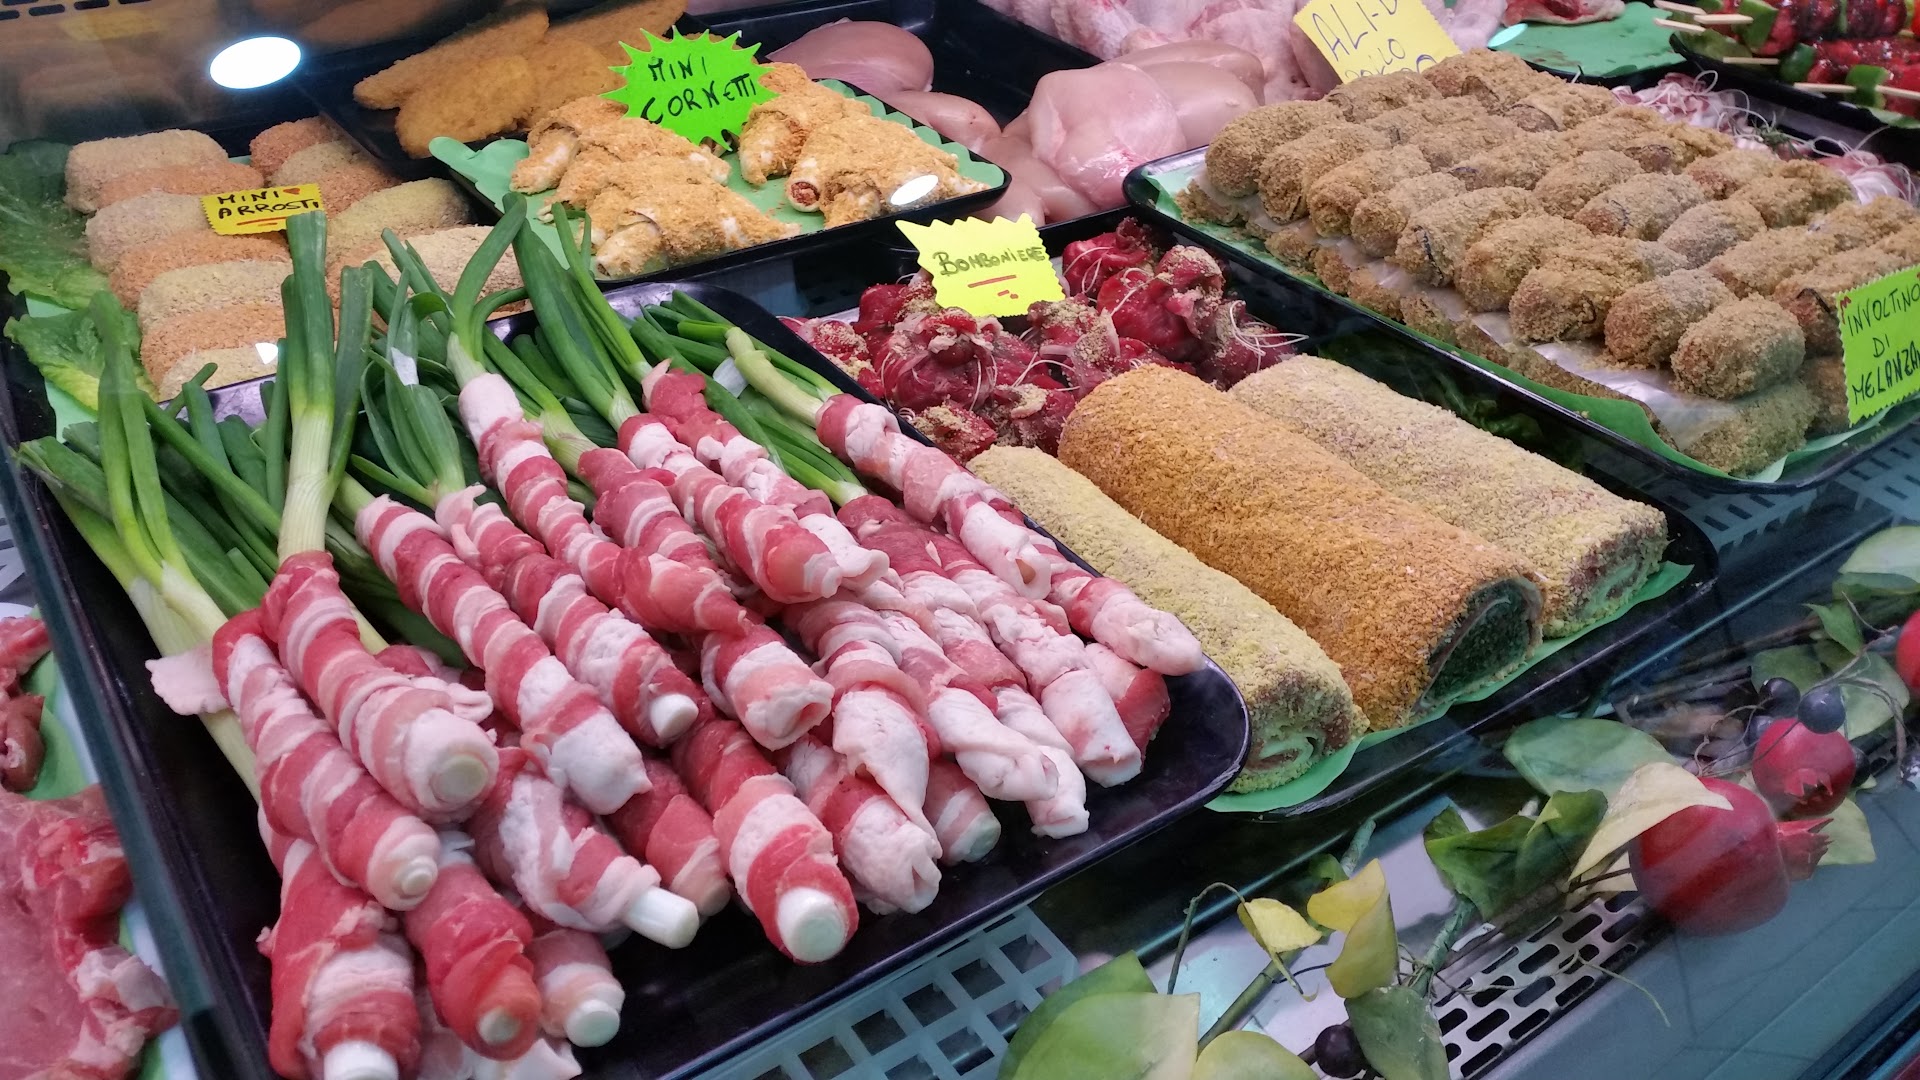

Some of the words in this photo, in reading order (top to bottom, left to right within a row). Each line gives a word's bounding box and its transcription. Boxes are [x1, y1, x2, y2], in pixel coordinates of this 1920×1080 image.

[647, 54, 708, 82] MINI
[640, 73, 757, 124] CORNETTI
[217, 190, 280, 204] MINI
[218, 199, 320, 219] ARROSTI
[932, 246, 1046, 277] BOMBONIERE
[1872, 334, 1891, 358] DI
